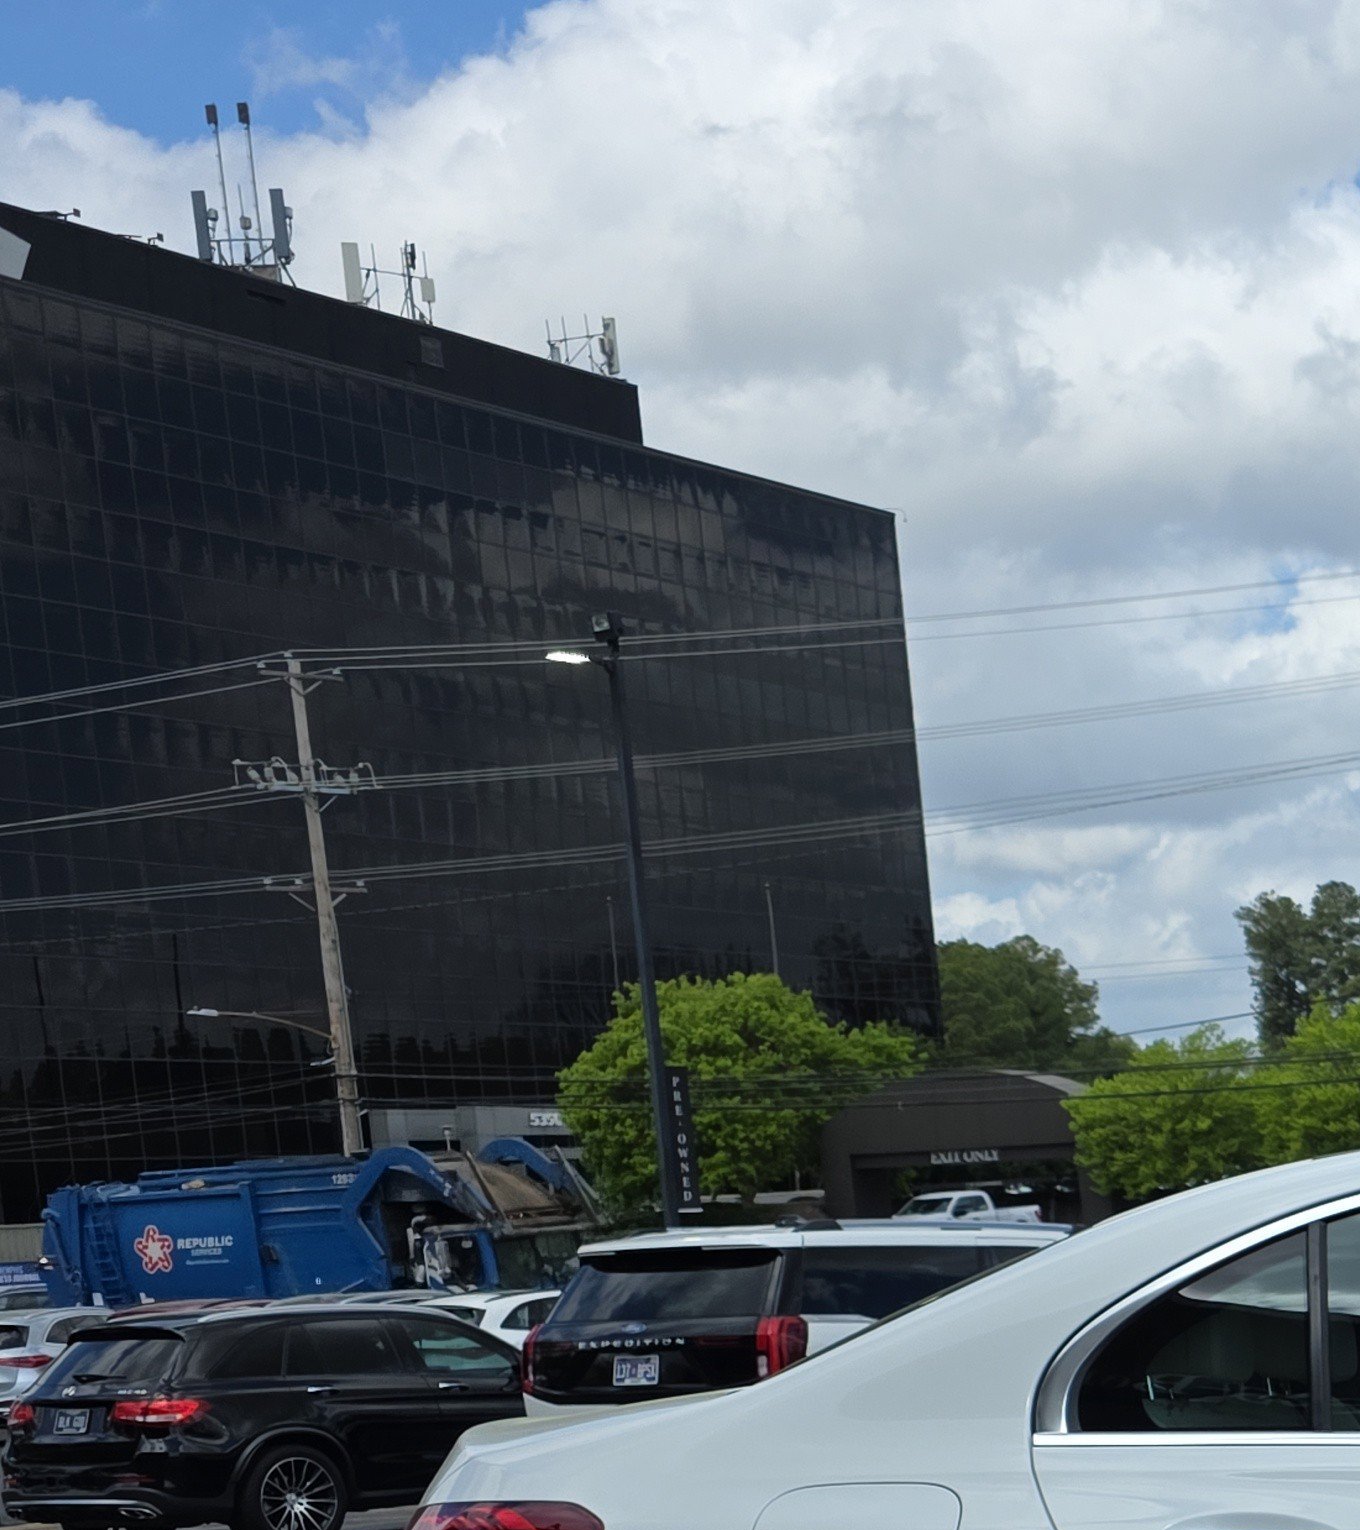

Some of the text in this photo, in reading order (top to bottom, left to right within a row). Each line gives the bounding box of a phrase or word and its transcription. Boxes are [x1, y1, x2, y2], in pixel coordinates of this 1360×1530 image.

[930, 1149, 998, 1165] EXIT ONLY
[176, 1235, 234, 1250] REPUBLIC
[578, 1338, 686, 1350] EXPEDITION
